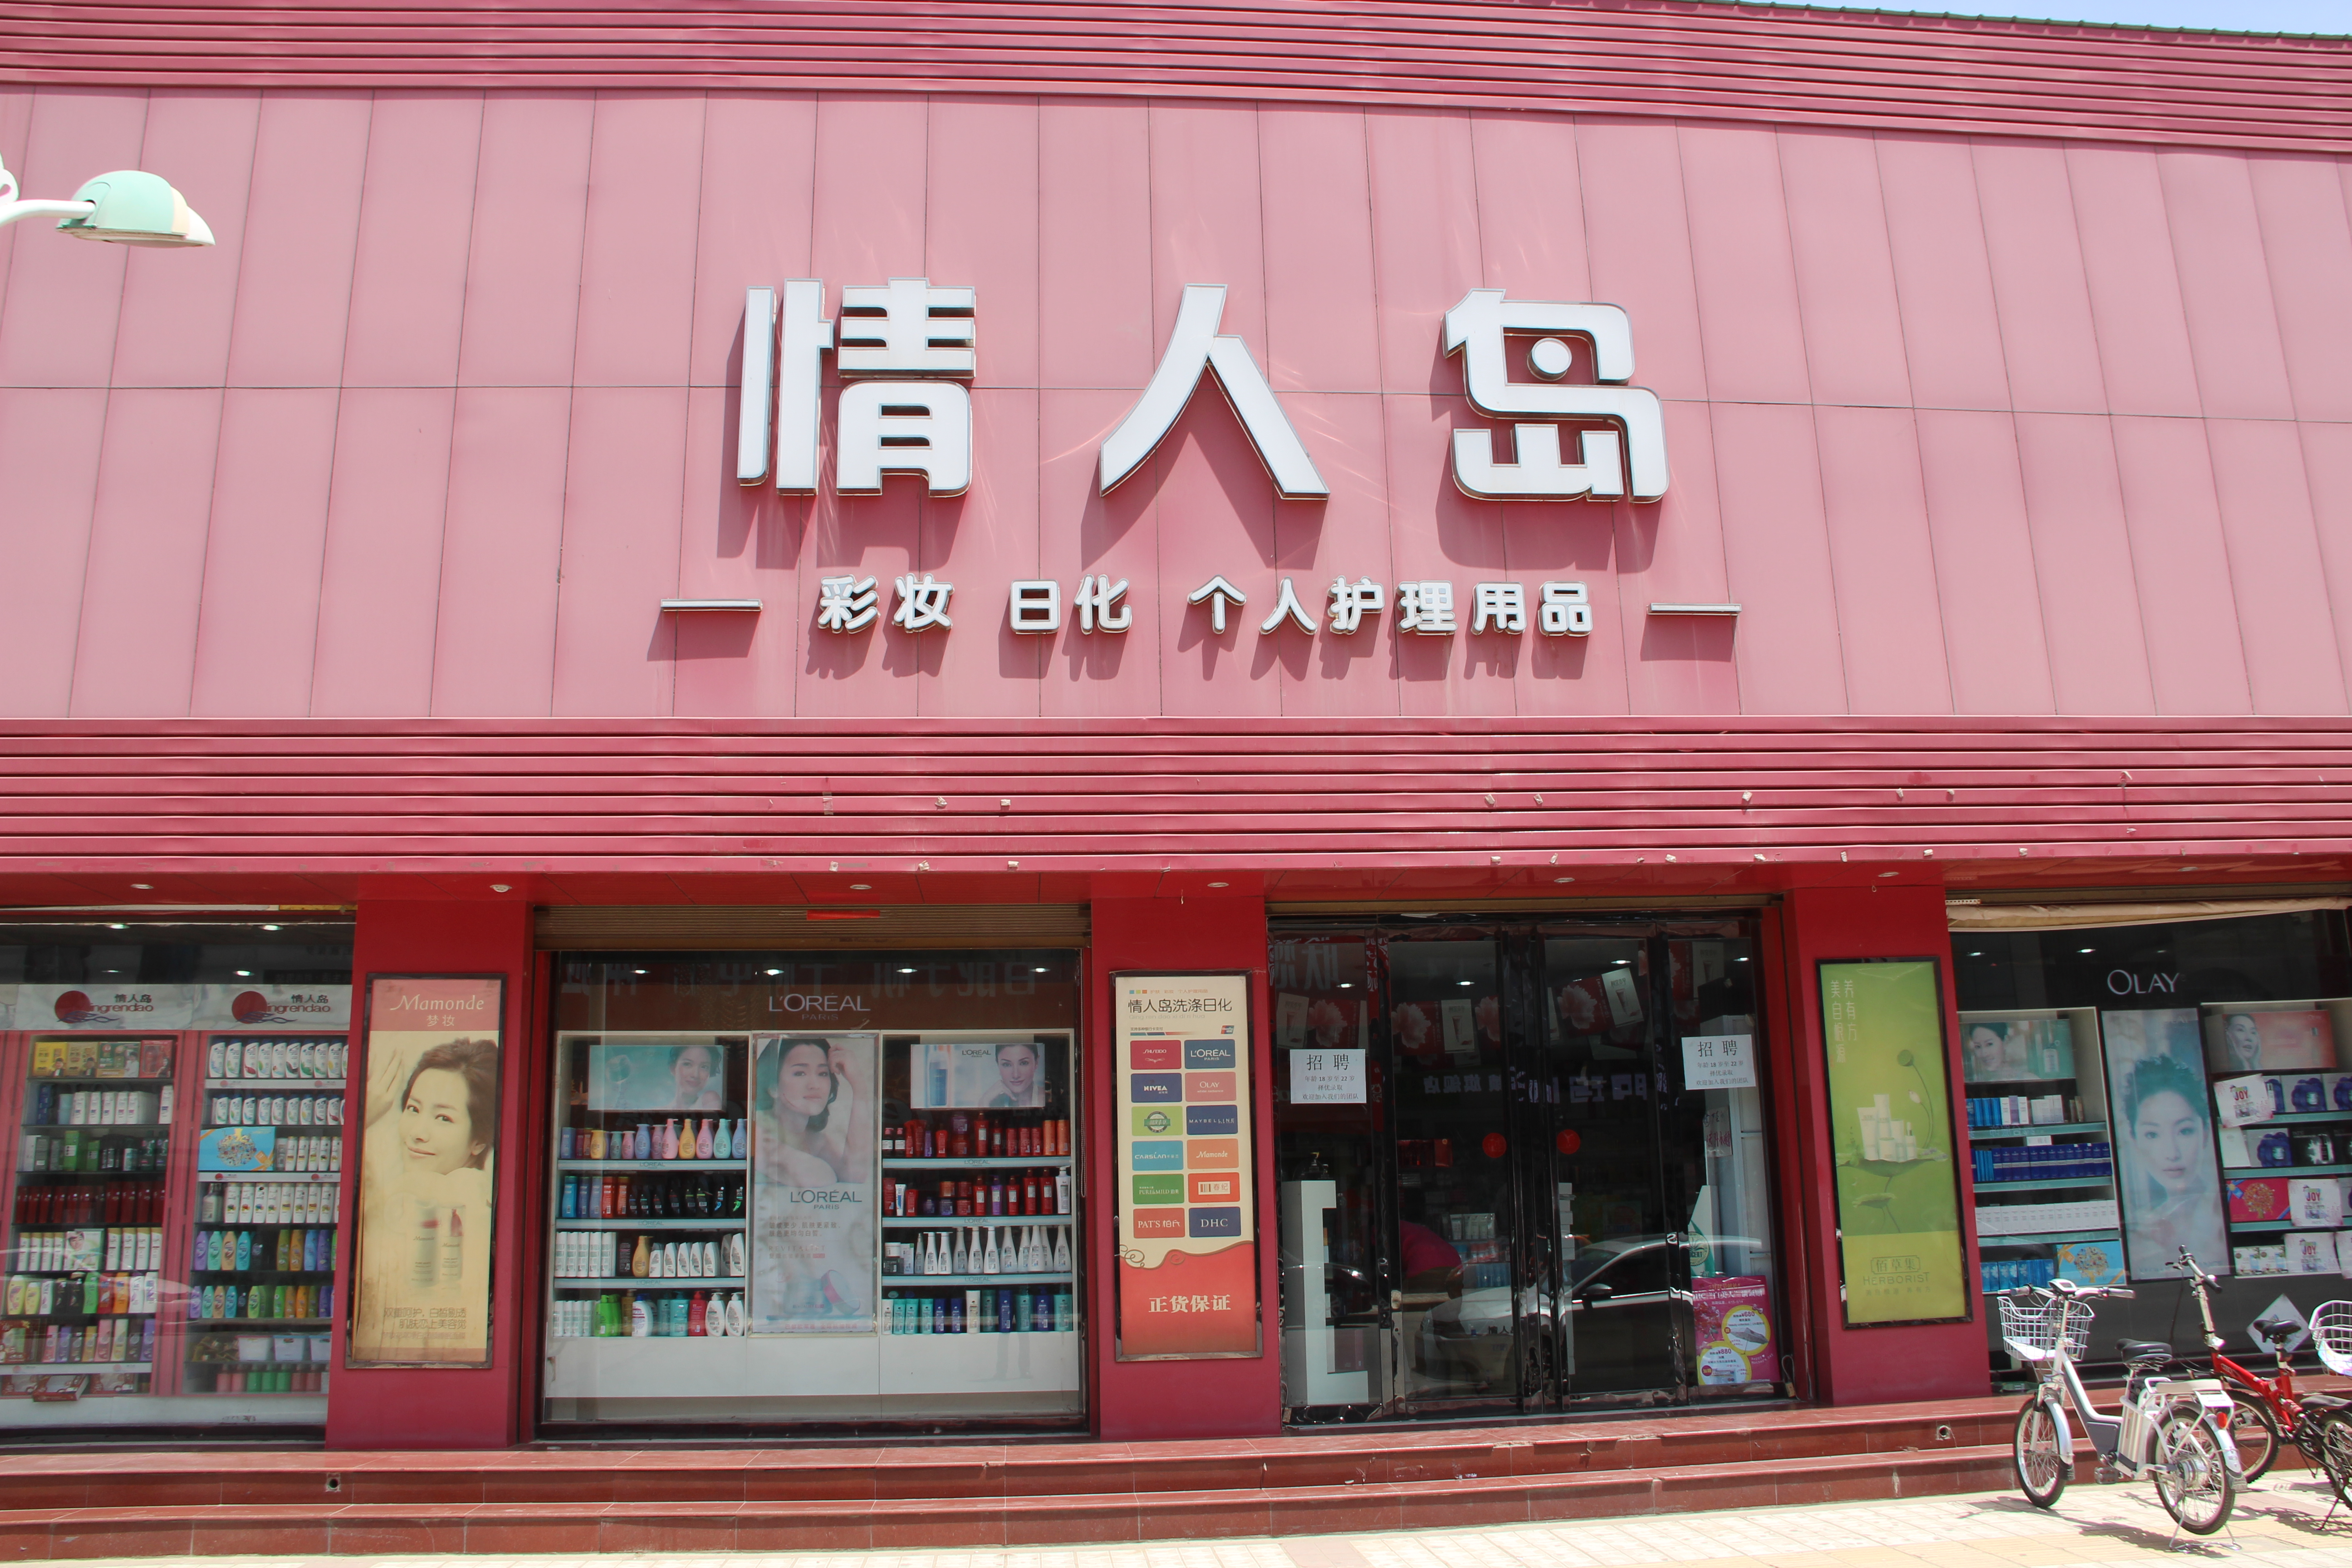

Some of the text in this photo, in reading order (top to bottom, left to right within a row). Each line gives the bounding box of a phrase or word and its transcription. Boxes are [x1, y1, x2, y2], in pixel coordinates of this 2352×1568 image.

[737, 278, 1669, 504] 情人岛
[818, 573, 1593, 637] 彩妆 日化 个人护理用品
[2107, 969, 2180, 995] OLAY
[114, 994, 152, 1003] 情人岛
[291, 995, 329, 1004] 情人岛
[390, 994, 485, 1010] Mamonde
[769, 993, 871, 1011] L'ORÉAL
[1128, 998, 1232, 1013] 情人岛洗涤日化
[426, 1014, 456, 1027] 梦妆
[1191, 1049, 1231, 1057] L'ORÉAL
[1697, 1039, 1738, 1057] 招聘
[1306, 1054, 1350, 1071] 招聘
[1696, 1077, 1749, 1086] 欢迎加入我们的团队
[2234, 1090, 2248, 1101] JOY
[1213, 1183, 1228, 1191] 春纪
[790, 1189, 862, 1203] L'ORÉAL
[2306, 1192, 2321, 1201] JOY
[1137, 1220, 1181, 1228] PAT'S 柏氏
[1200, 1218, 1229, 1227] DHC
[2302, 1245, 2317, 1255] JOY
[1863, 1272, 1930, 1285] HERBORIST
[1148, 1294, 1231, 1313] 正货保证
[399, 1318, 466, 1329] 肌肤恋上美容觉
